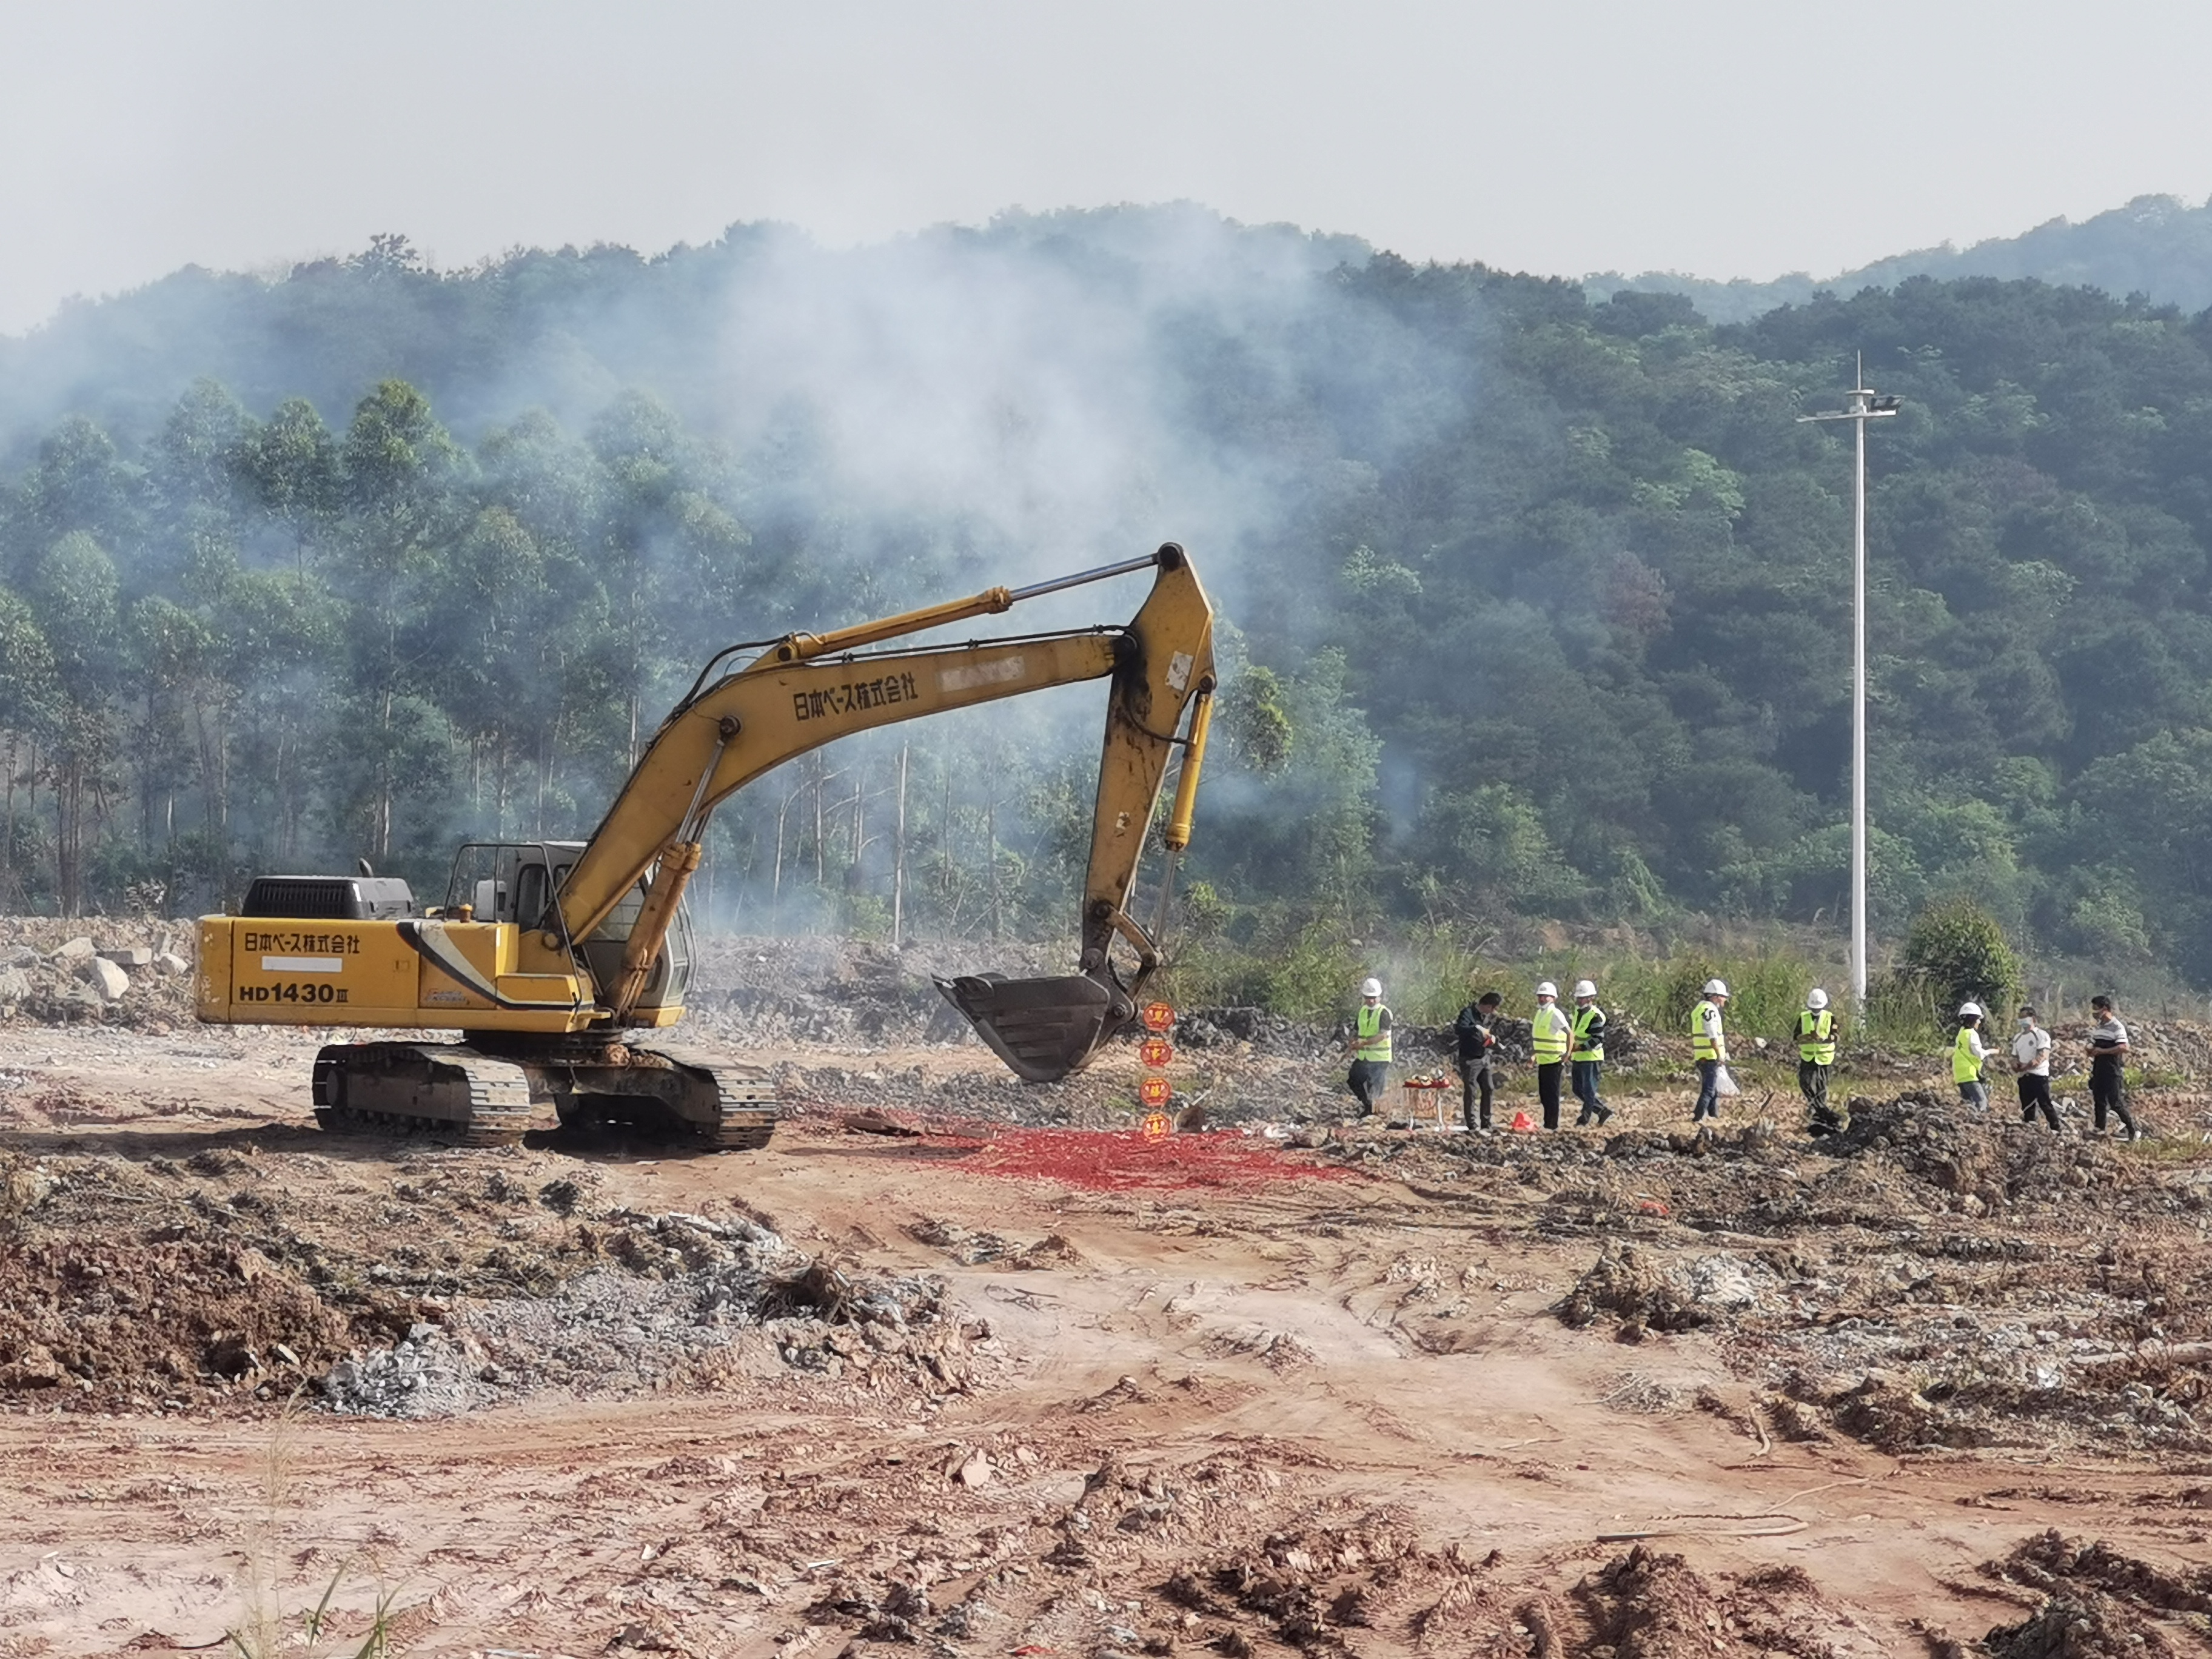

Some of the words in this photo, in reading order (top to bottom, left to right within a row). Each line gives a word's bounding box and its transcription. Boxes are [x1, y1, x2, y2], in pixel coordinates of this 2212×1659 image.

[793, 671, 919, 721] 日本ベース株式会社
[245, 933, 360, 954] 日本ベース株式会社
